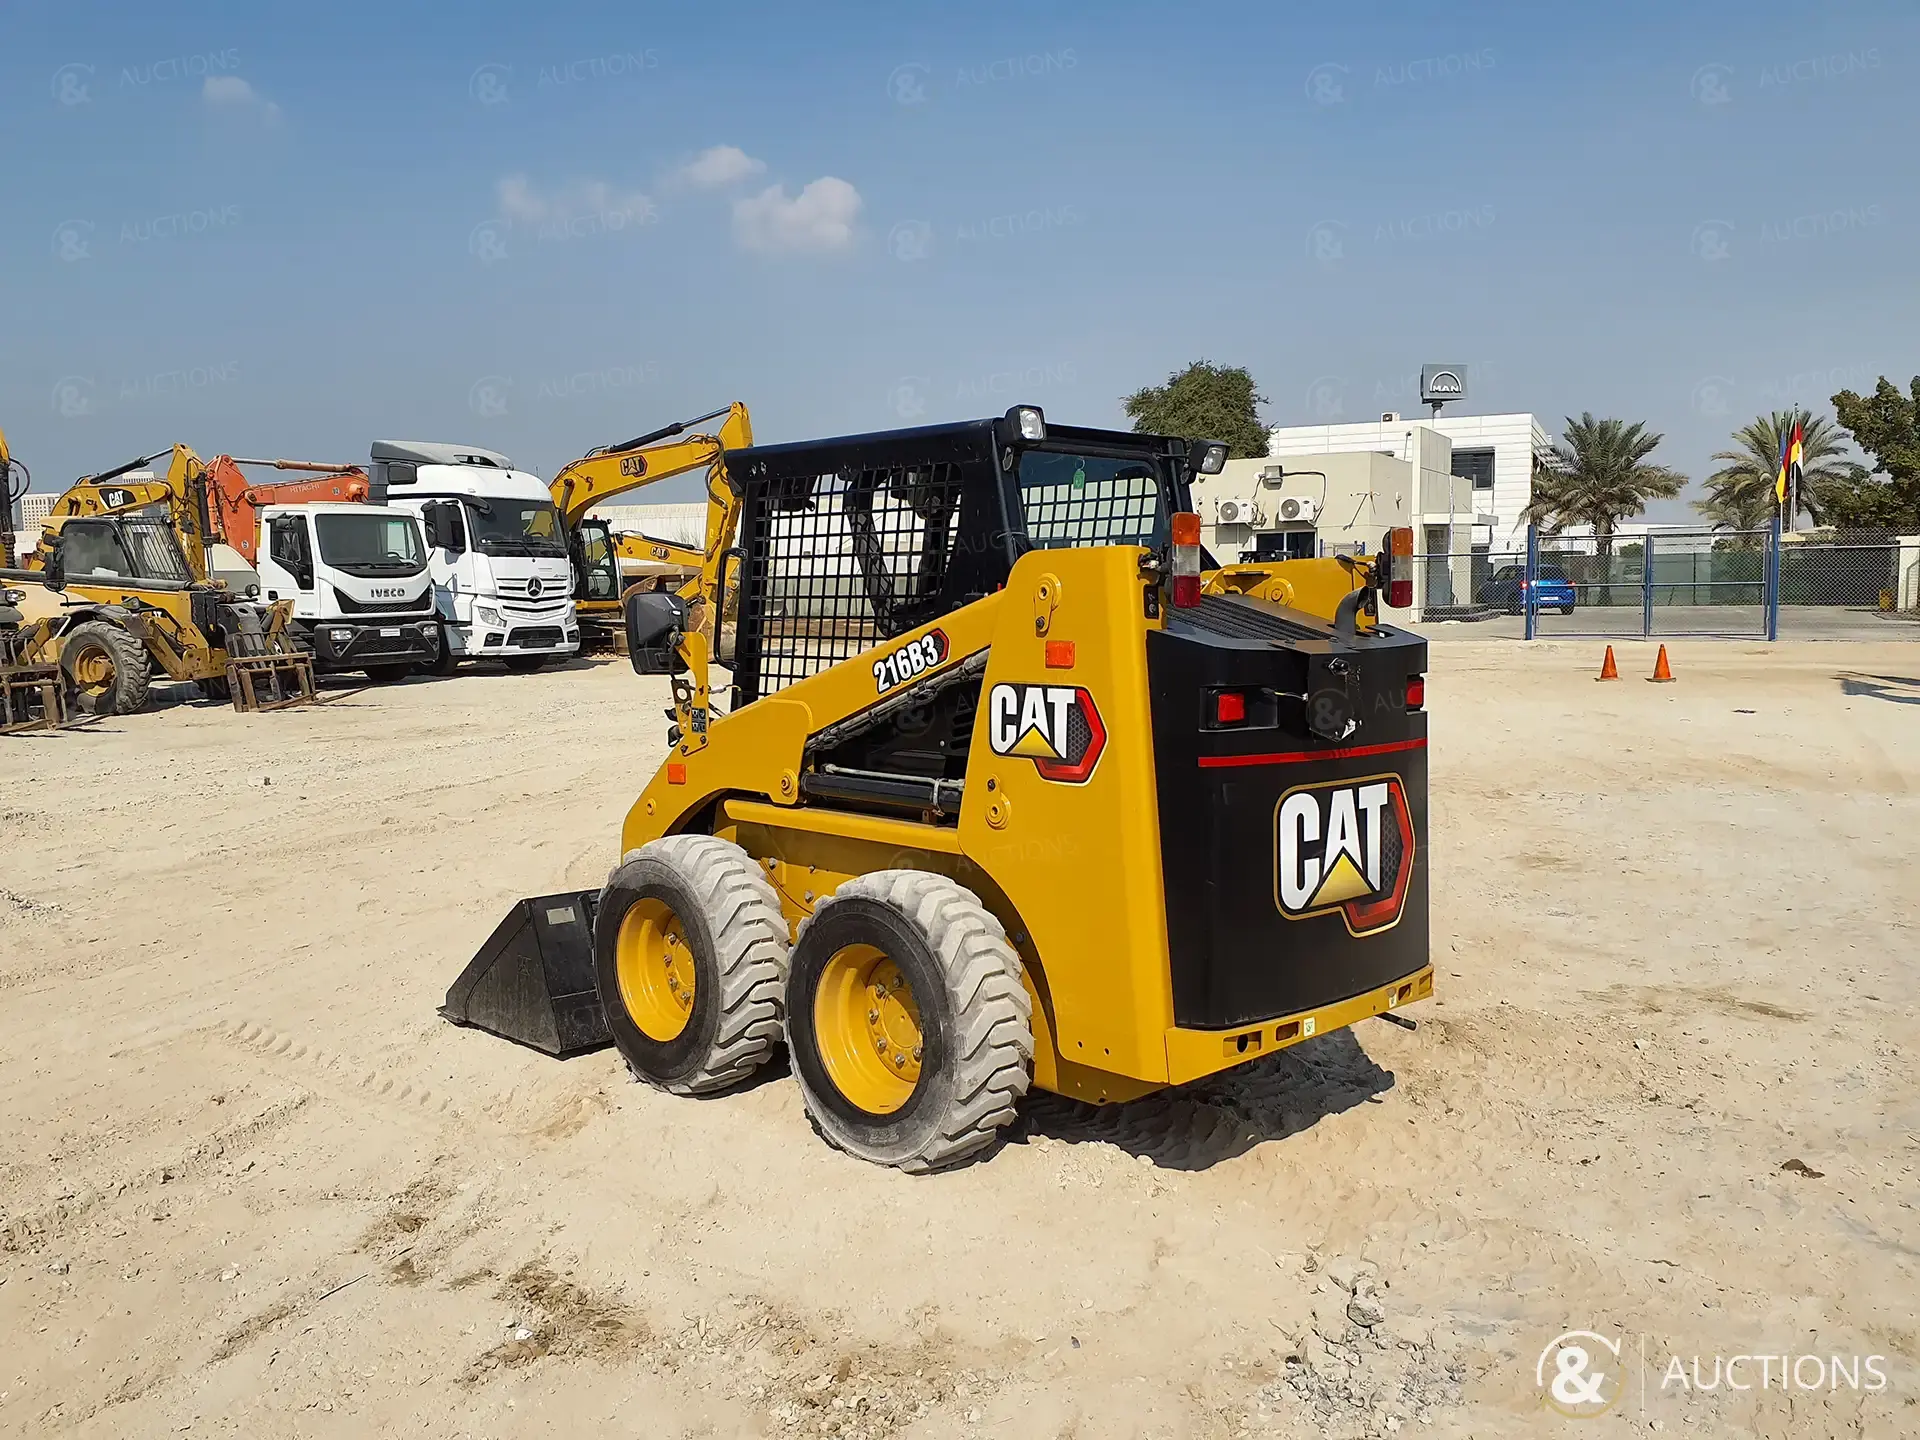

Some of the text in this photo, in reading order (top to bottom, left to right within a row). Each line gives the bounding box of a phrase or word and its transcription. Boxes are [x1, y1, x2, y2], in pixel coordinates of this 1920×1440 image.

[620, 456, 641, 475] CAT
[290, 482, 320, 493] HITACHI
[109, 490, 123, 507] CAT
[650, 547, 666, 558] CAT
[370, 587, 406, 598] IVECO
[873, 634, 940, 694] 216B3
[991, 684, 1076, 759] CAT
[1279, 782, 1388, 910] CAT
